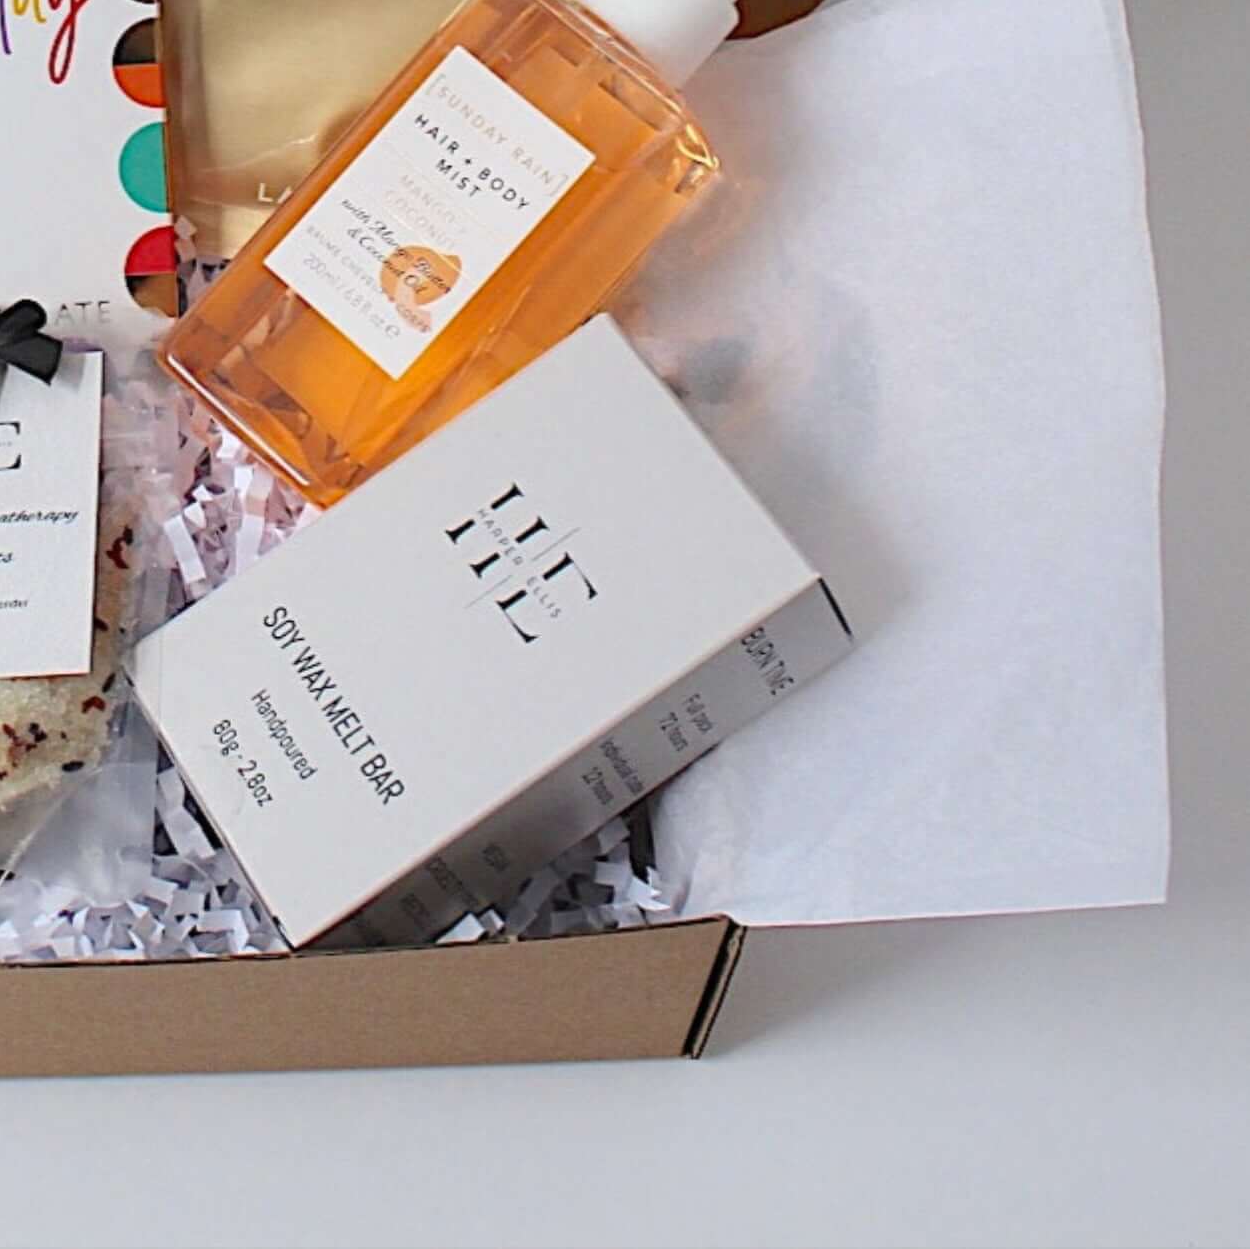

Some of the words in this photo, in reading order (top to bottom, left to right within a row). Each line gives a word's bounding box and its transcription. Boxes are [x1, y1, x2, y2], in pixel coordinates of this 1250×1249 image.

[414, 114, 461, 155] HAIR
[477, 167, 531, 210] BODY
[435, 158, 482, 199] MIST
[741, 624, 776, 665] BURN
[250, 688, 319, 781] Handpoured
[259, 604, 306, 654] SOY
[288, 646, 340, 703] WAX
[320, 693, 375, 757] MELT
[358, 752, 405, 805] BAR
[210, 719, 242, 755] 80g
[237, 758, 276, 807] 2.8oz
